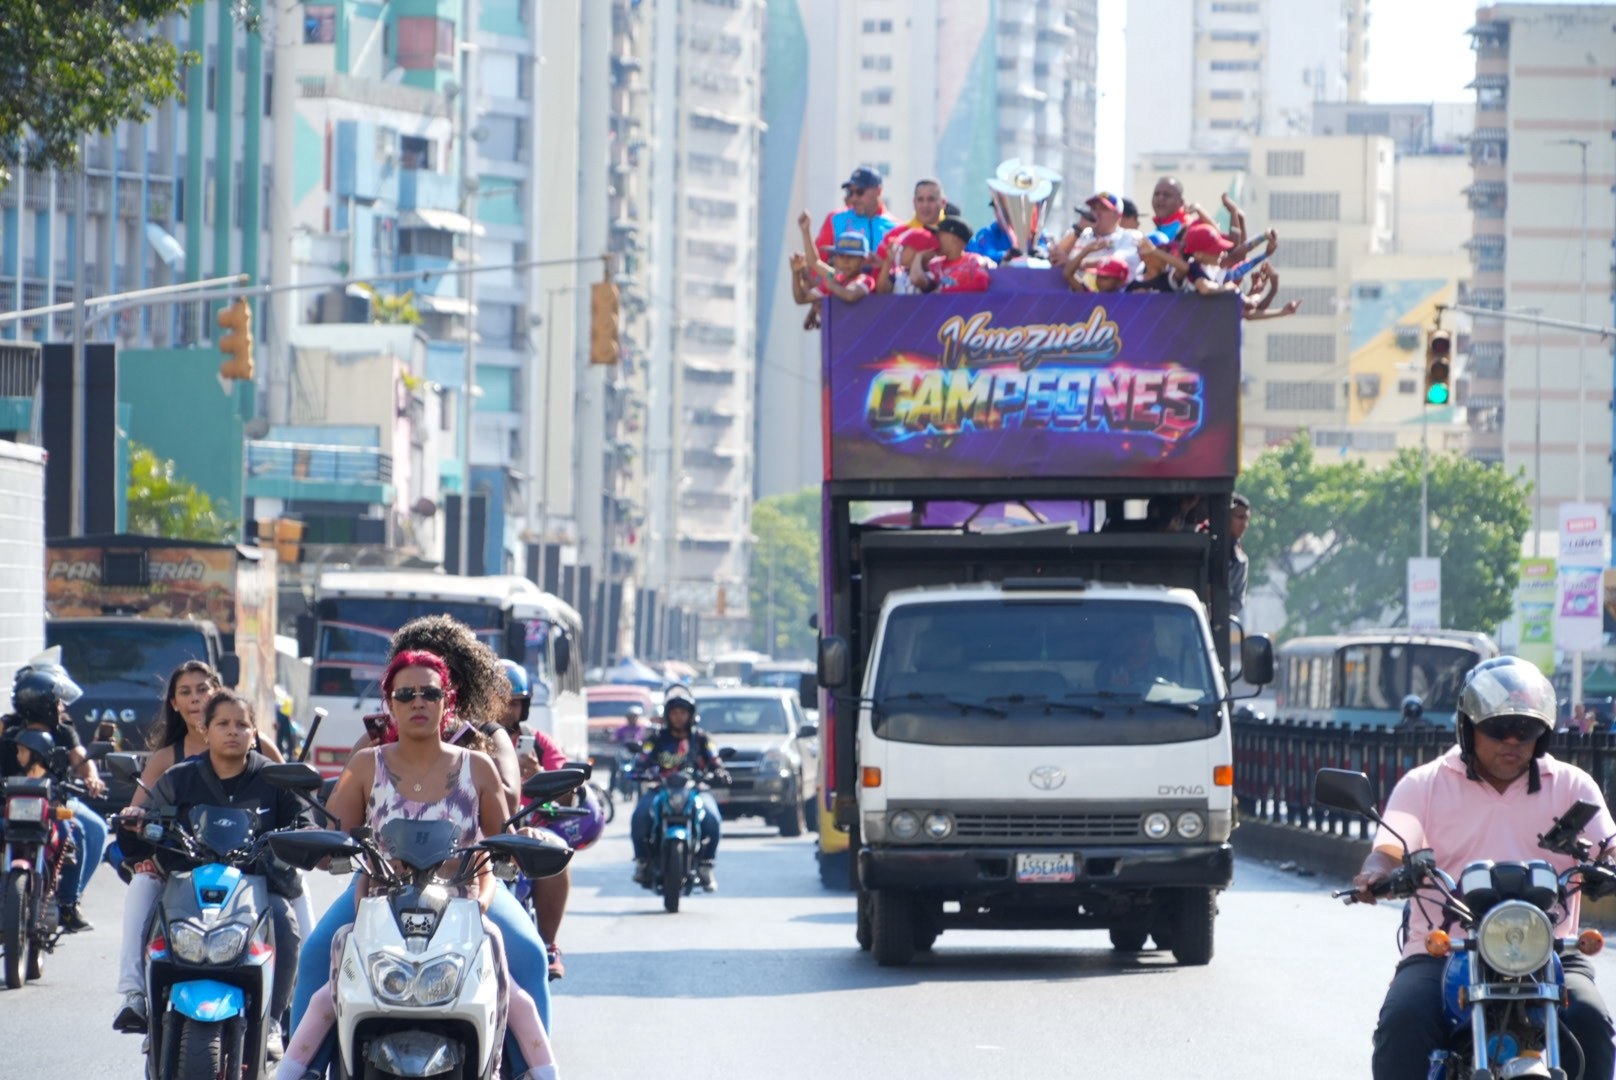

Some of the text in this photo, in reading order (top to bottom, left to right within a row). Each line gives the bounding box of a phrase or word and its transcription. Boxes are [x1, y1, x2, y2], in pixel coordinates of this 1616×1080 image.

[939, 306, 1121, 370] Venezuela
[868, 367, 1202, 440] CAMPEONES
[85, 708, 136, 723] JAC
[1157, 785, 1205, 796] DYNA
